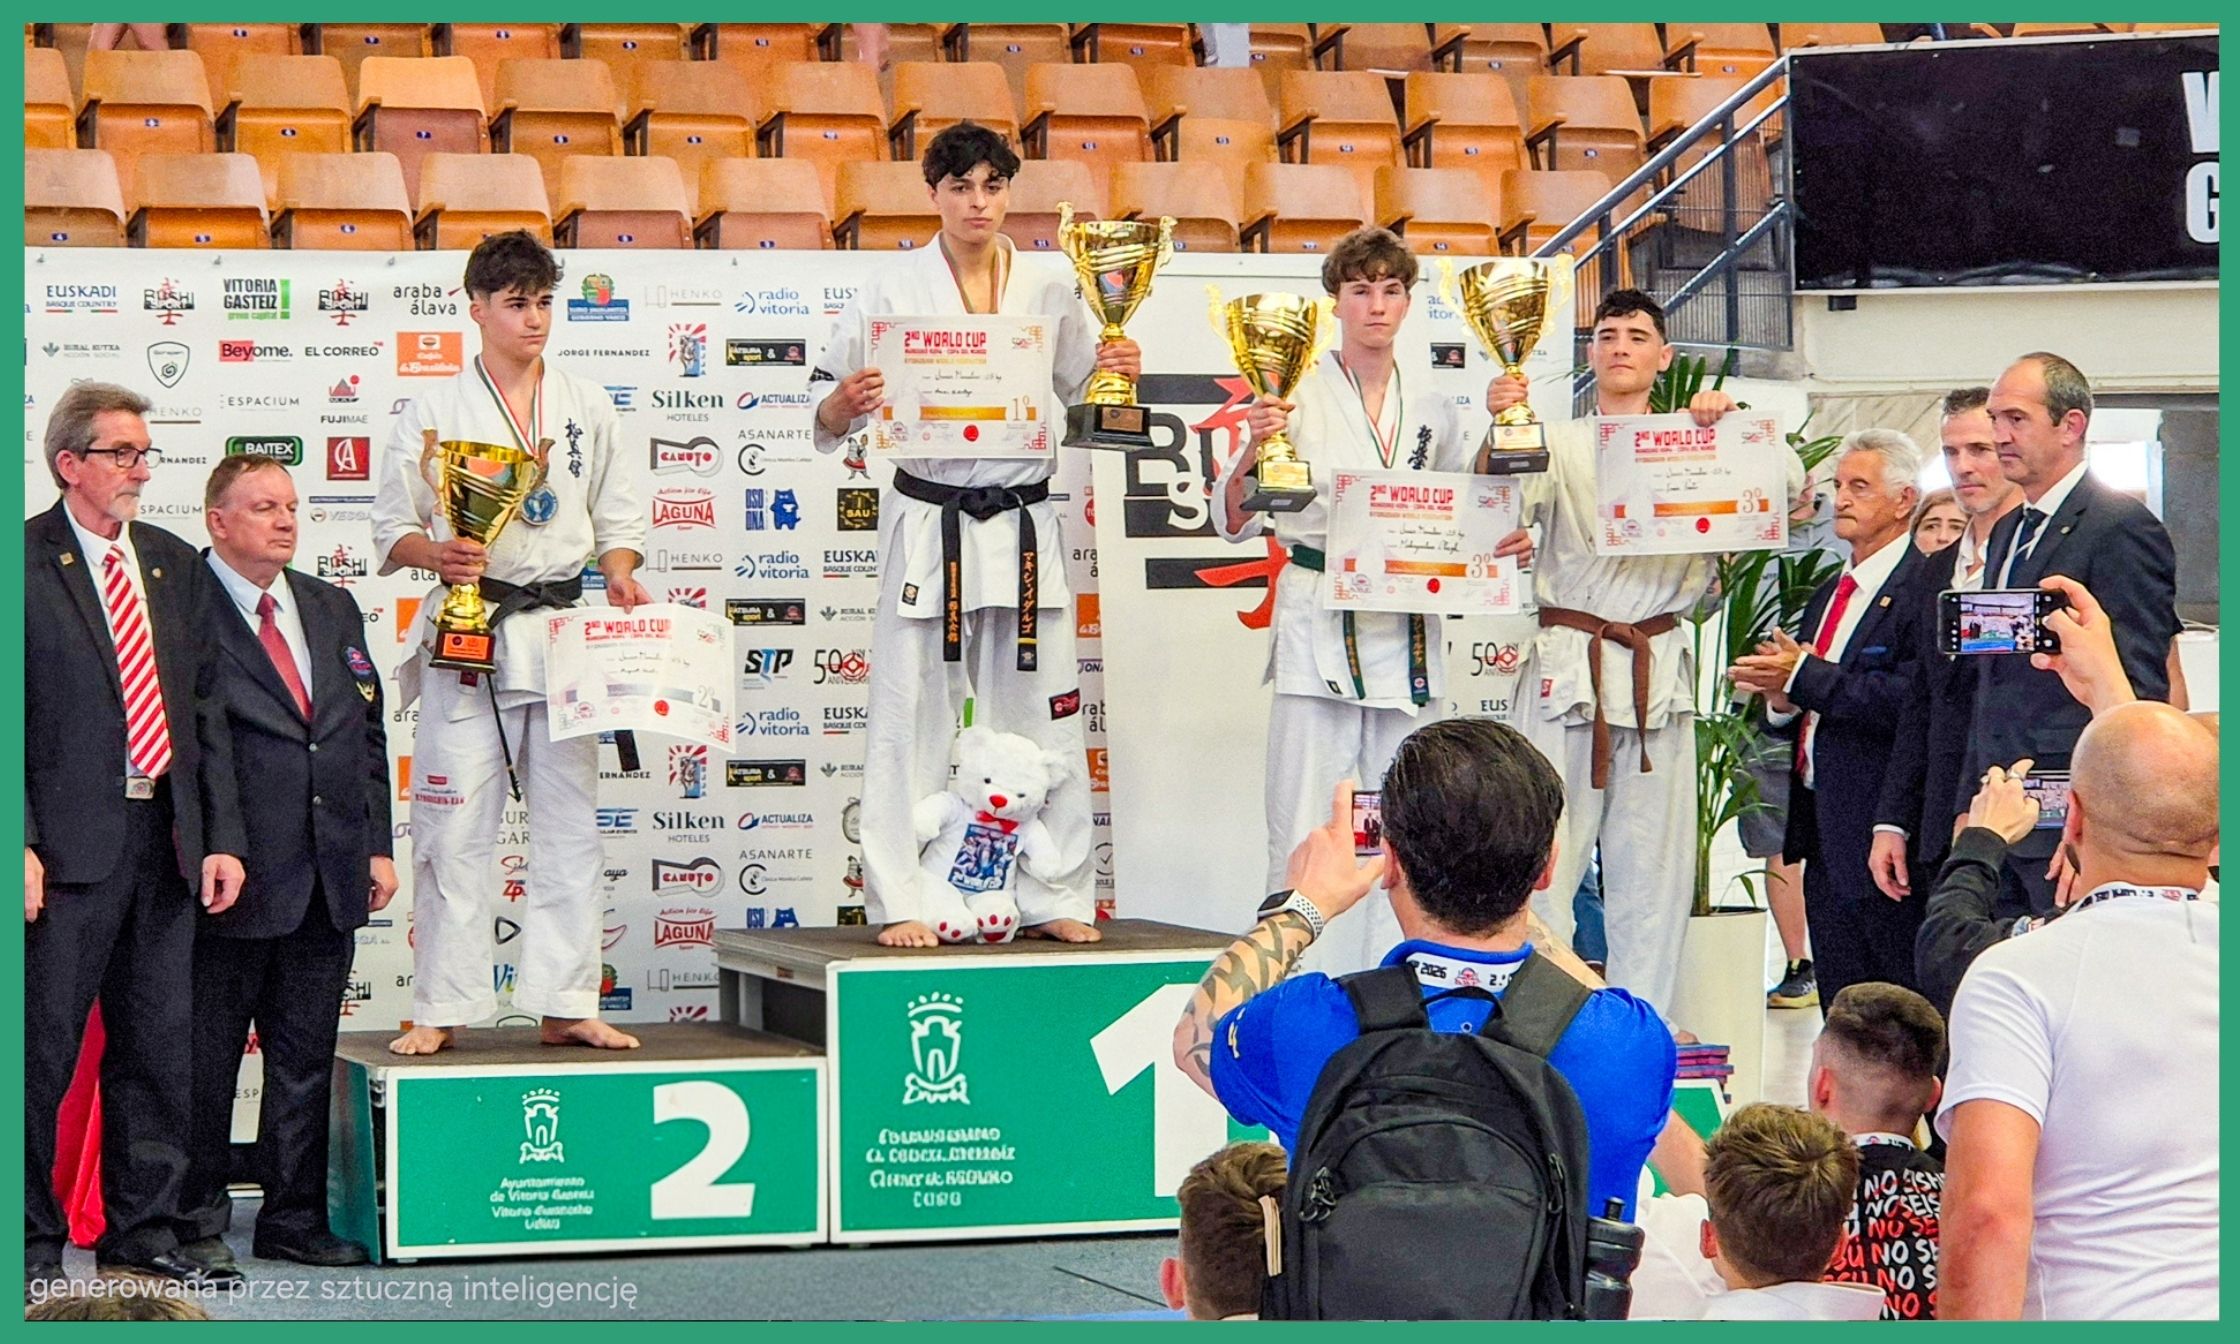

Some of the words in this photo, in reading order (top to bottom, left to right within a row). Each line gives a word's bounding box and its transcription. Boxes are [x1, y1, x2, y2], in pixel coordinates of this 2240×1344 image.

[46, 285, 117, 298] EUSKADI
[223, 279, 277, 293] VITORIA
[393, 283, 442, 298] araba
[759, 287, 798, 300] radio
[671, 289, 722, 299] HENKO
[223, 295, 277, 309] GASTEIZ
[410, 299, 457, 315] álava
[759, 301, 809, 315] vitoria
[923, 331, 962, 347] WORLD
[965, 331, 987, 347] CUP
[222, 344, 293, 360] Beyome.
[305, 347, 320, 356] EL
[323, 346, 379, 356] CORREO
[228, 397, 299, 406] ESPACIUM
[652, 388, 723, 408] Silken
[321, 415, 368, 424] FUJIMAE
[667, 413, 709, 422] HOTELES
[738, 430, 811, 440] ASANARTE
[1653, 430, 1692, 446] WORLD
[1695, 428, 1716, 444] CUP
[245, 442, 294, 454] BAITEX
[661, 452, 713, 467] CANUTO
[1389, 486, 1430, 503] WORLD
[1432, 487, 1454, 504] CUP
[652, 500, 715, 525] LAGUNA
[846, 509, 870, 517] SAU
[671, 553, 723, 564] HENKO
[759, 550, 799, 564] radio
[824, 550, 877, 563] EUSKA
[759, 566, 809, 579] vitoria
[603, 619, 646, 634] WORLD
[744, 649, 794, 674] STP
[813, 648, 843, 684] 50
[1470, 642, 1499, 677] 50
[759, 707, 800, 721] radio
[759, 722, 810, 736] vitoria
[653, 811, 725, 830] Silken
[761, 813, 813, 824] ACTUALIZA
[668, 834, 710, 843] HOTELES
[739, 848, 813, 859] ASANARTE
[662, 873, 714, 887] CANUTO
[655, 919, 715, 945] LAGUNA
[1420, 962, 1447, 979] 2026
[1090, 983, 1202, 1198] 1
[651, 1080, 755, 1220] 2
[1864, 1169, 1899, 1199] NO
[1865, 1195, 1899, 1218] NO
[1868, 1217, 1904, 1239] NO
[1871, 1240, 1909, 1266] NO
[1877, 1265, 1915, 1291] NO
[1883, 1292, 1920, 1318] NO
